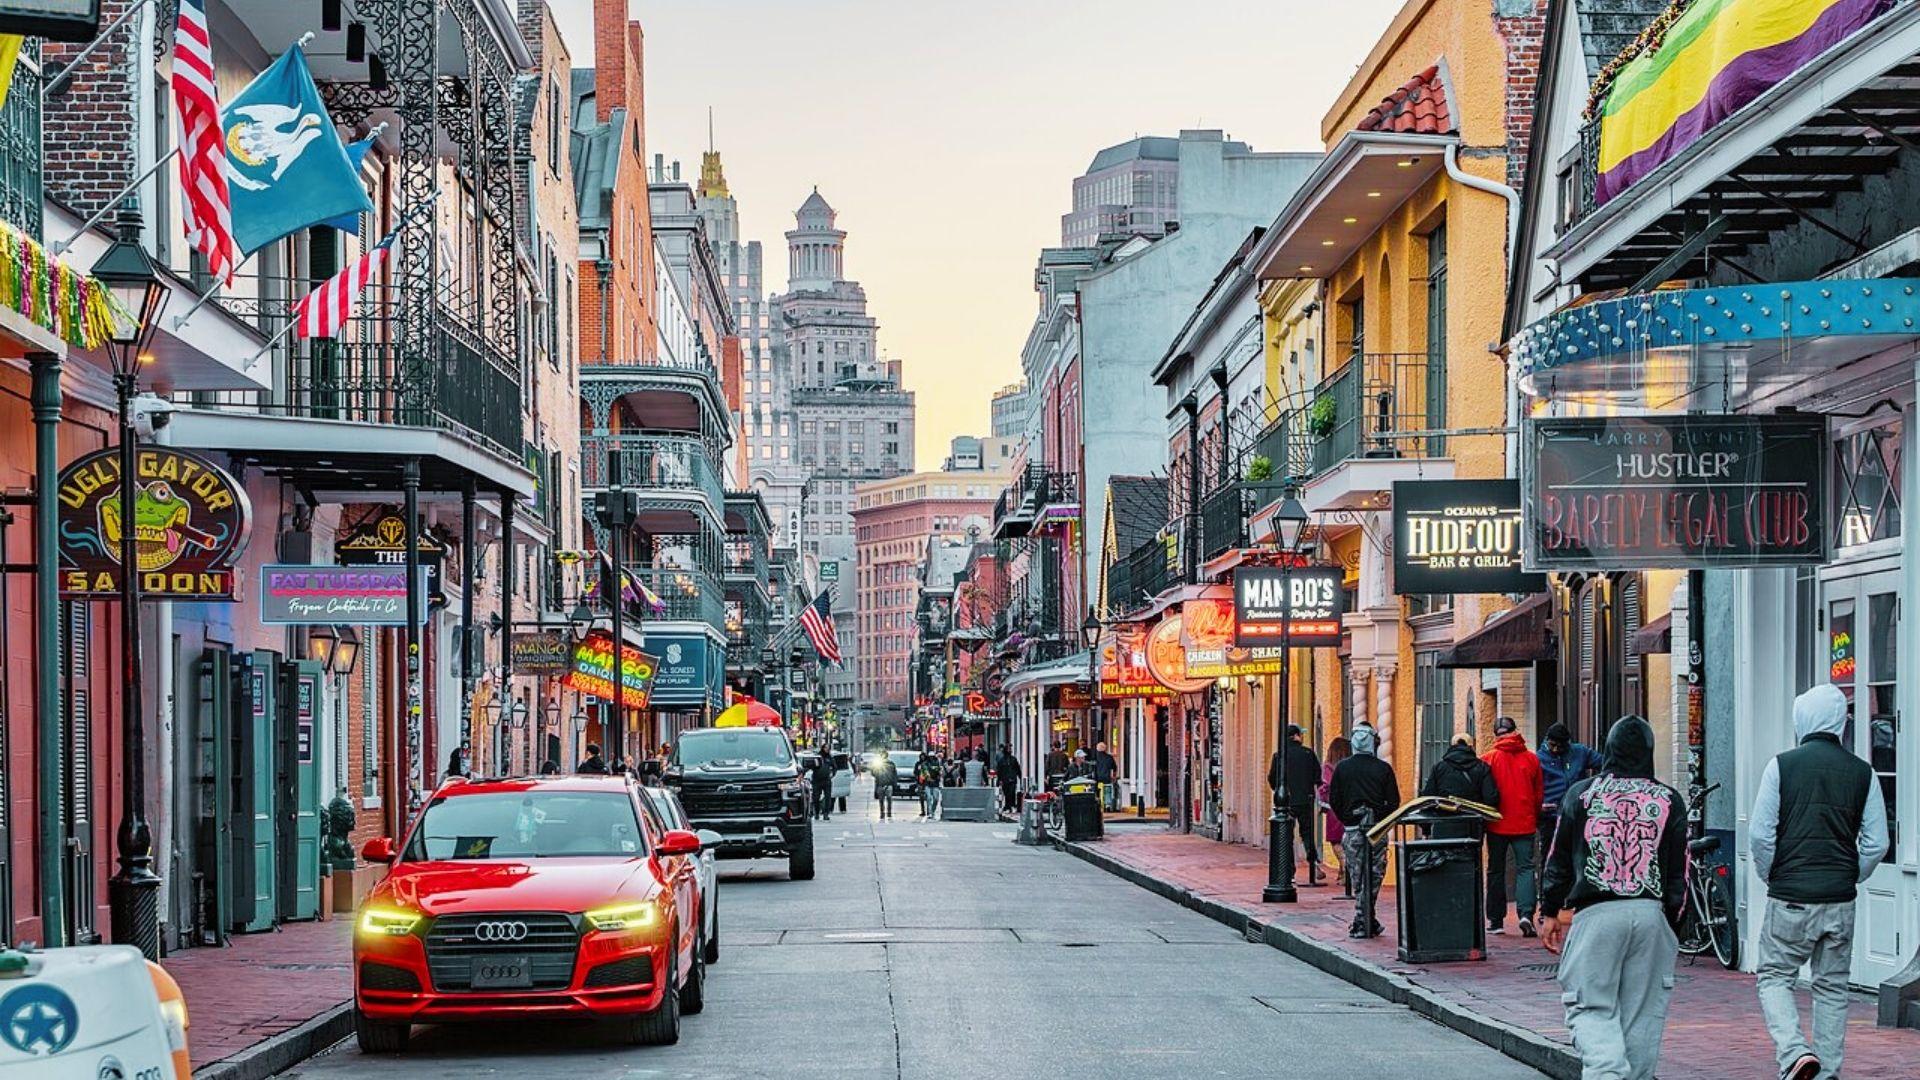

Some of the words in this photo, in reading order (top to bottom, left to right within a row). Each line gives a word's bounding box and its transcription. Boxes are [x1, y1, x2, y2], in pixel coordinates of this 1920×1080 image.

[1593, 431, 1664, 446] LARRY
[139, 452, 234, 513] GATOR
[1444, 505, 1498, 517] OCEANA'S
[1544, 490, 1646, 550] BARELY
[1655, 490, 1736, 549] LEGAL
[1743, 490, 1810, 548] CLUB
[1429, 557, 1456, 569] BAR
[1458, 557, 1470, 568] &
[1473, 555, 1512, 568] GRILL
[66, 571, 222, 593] SAOON
[271, 573, 310, 590] FAT
[326, 596, 370, 614] Cocktails
[385, 599, 399, 614] Go
[514, 642, 568, 655] MANGO
[595, 639, 638, 660] MAGO
[579, 662, 643, 689] DAIQRIS
